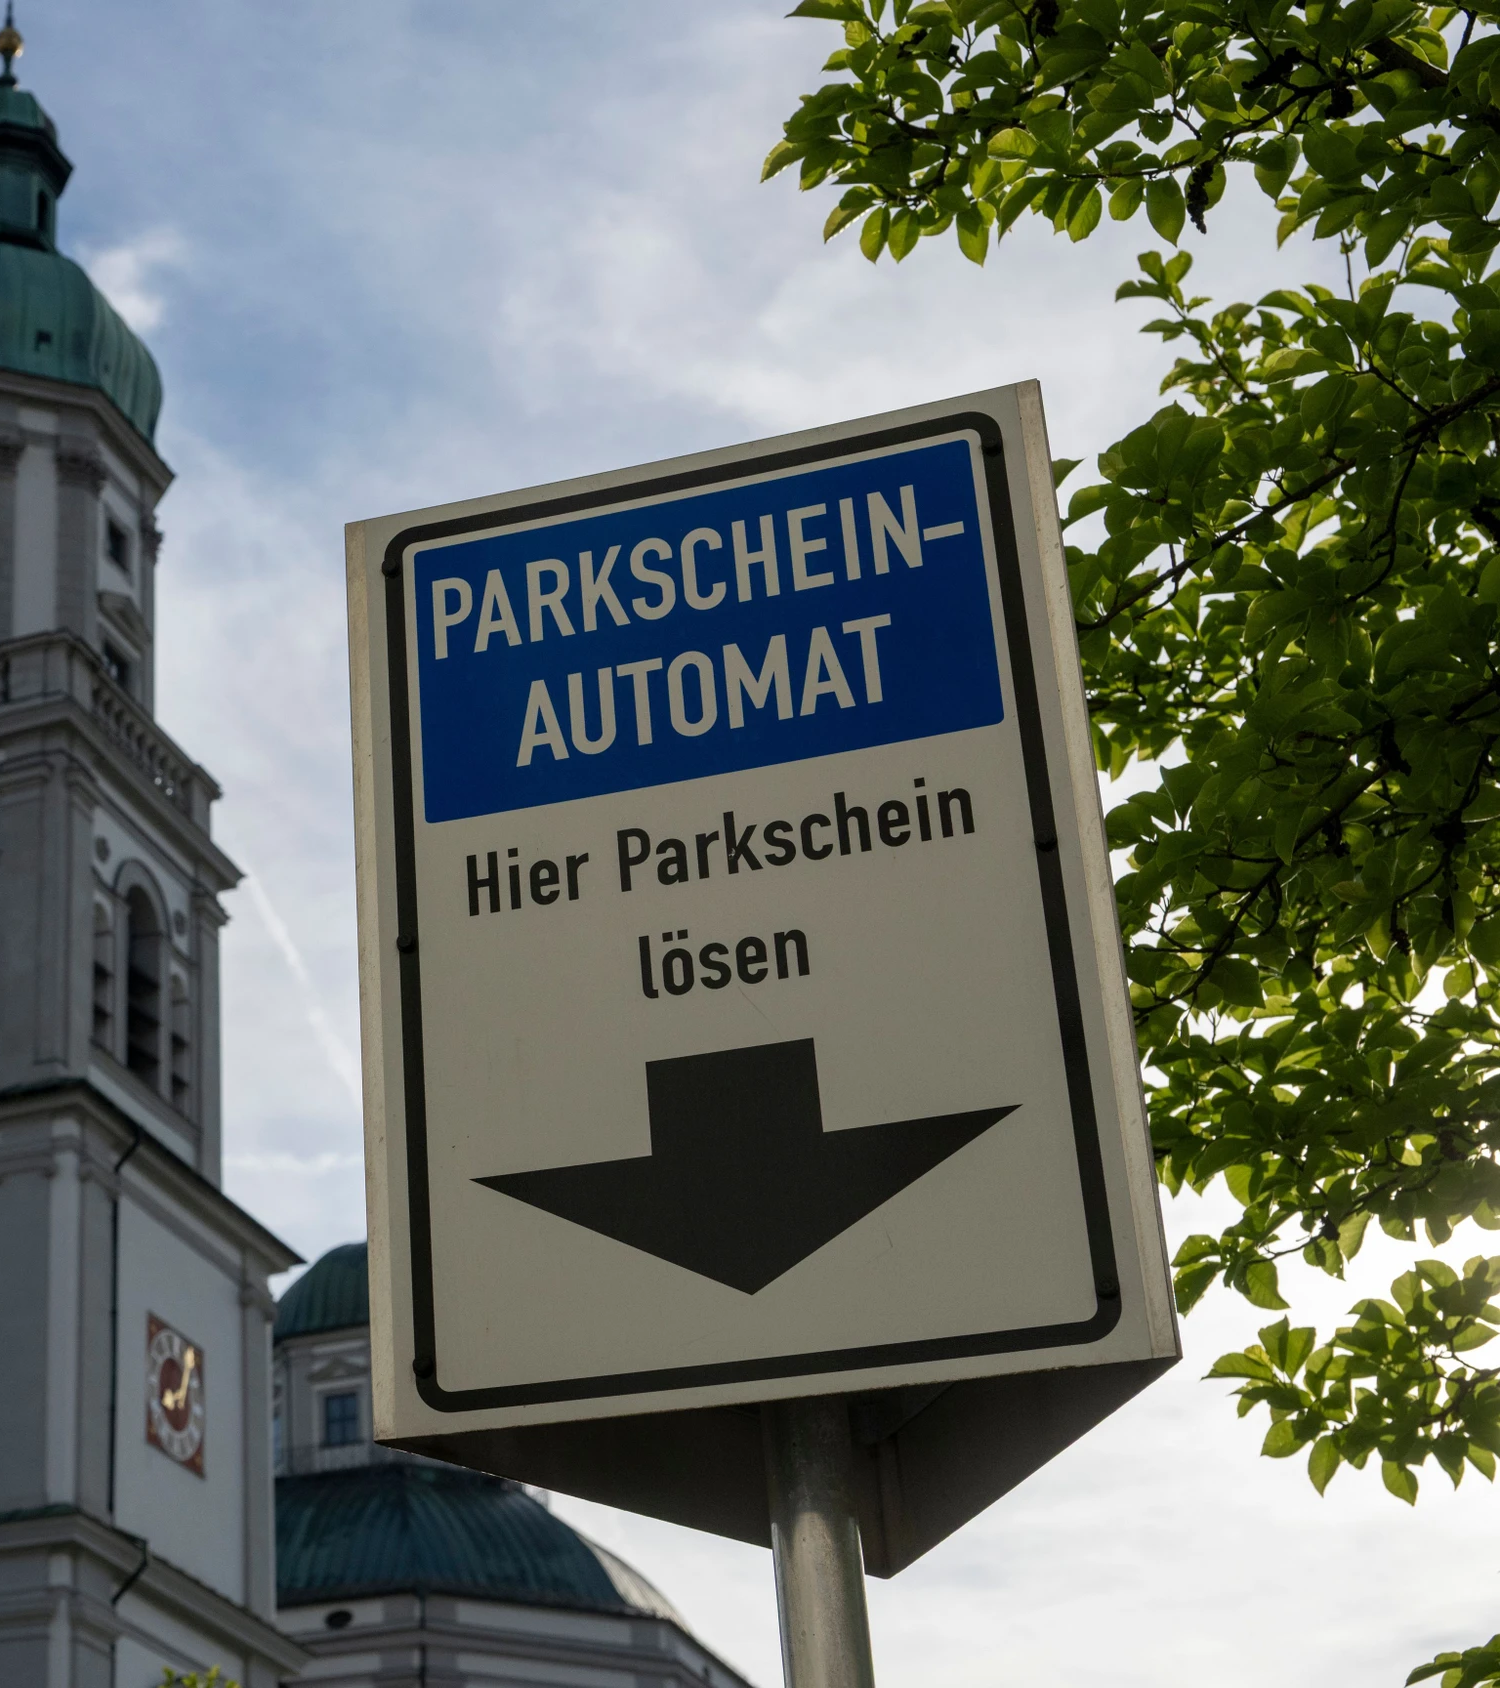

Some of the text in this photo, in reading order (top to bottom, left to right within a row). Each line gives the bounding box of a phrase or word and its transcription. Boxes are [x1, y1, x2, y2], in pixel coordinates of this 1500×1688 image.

[431, 484, 965, 660] PARKSCHEIN-
[516, 613, 893, 768] AUTOMAT
[466, 777, 976, 917] Hier Parkschein
[638, 926, 811, 1000] lösen
